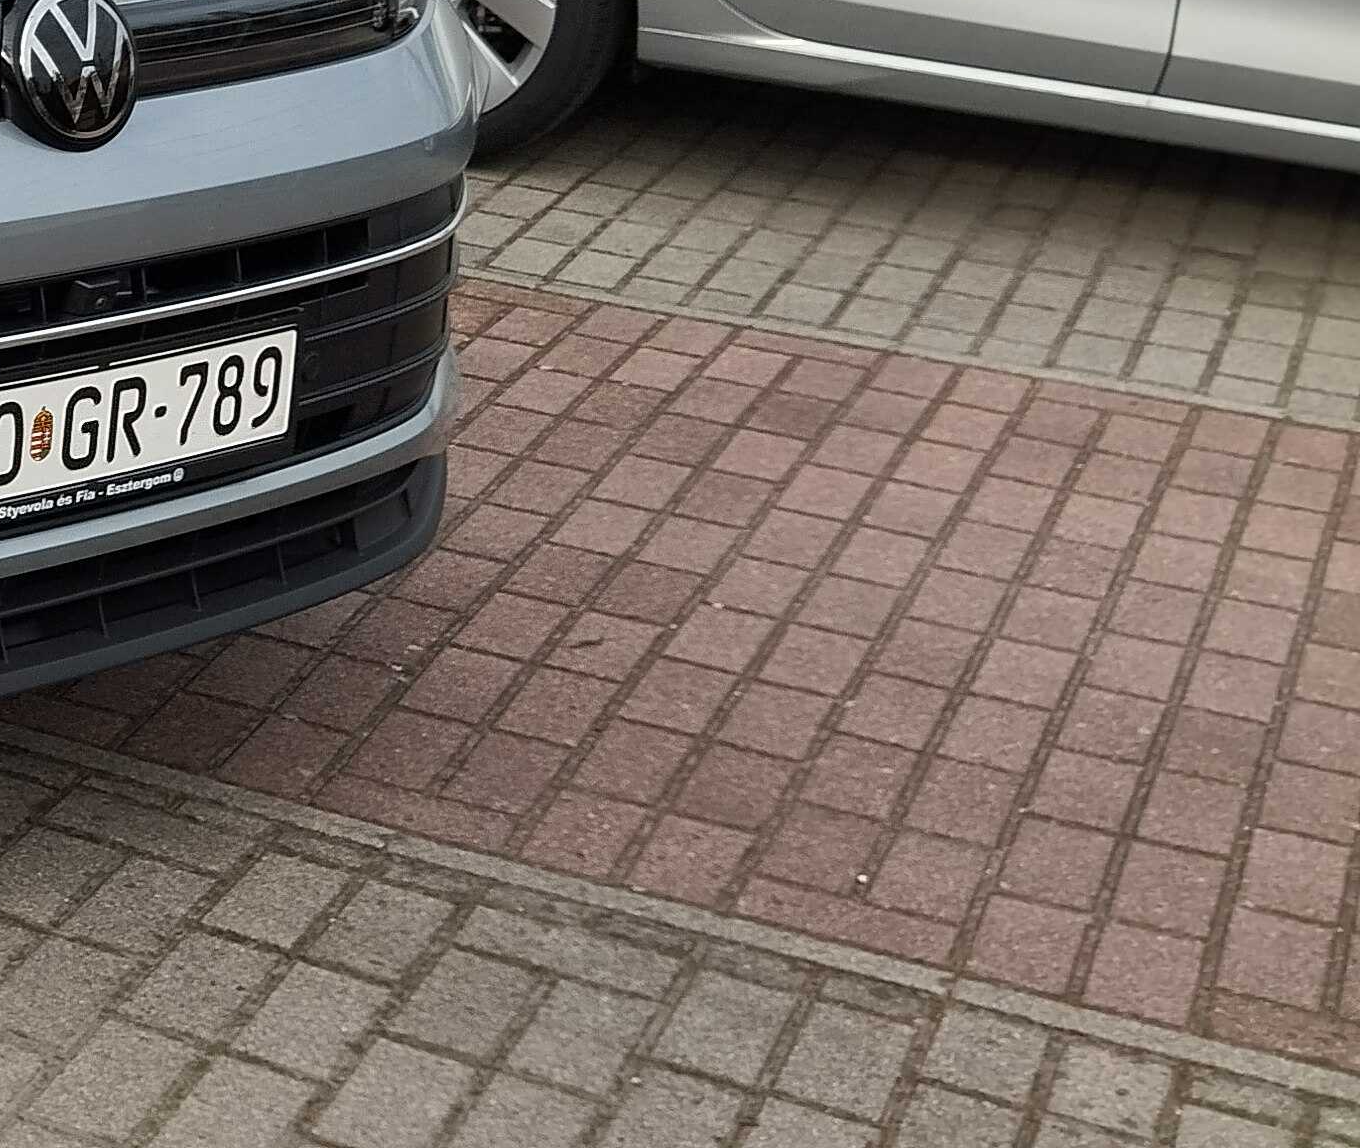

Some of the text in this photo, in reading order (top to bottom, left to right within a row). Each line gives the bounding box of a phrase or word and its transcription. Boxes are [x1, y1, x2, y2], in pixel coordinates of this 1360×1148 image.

[61, 346, 283, 471] GR-789
[57, 493, 73, 507] és
[75, 489, 96, 503] Fia
[106, 472, 173, 496] Esztergom
